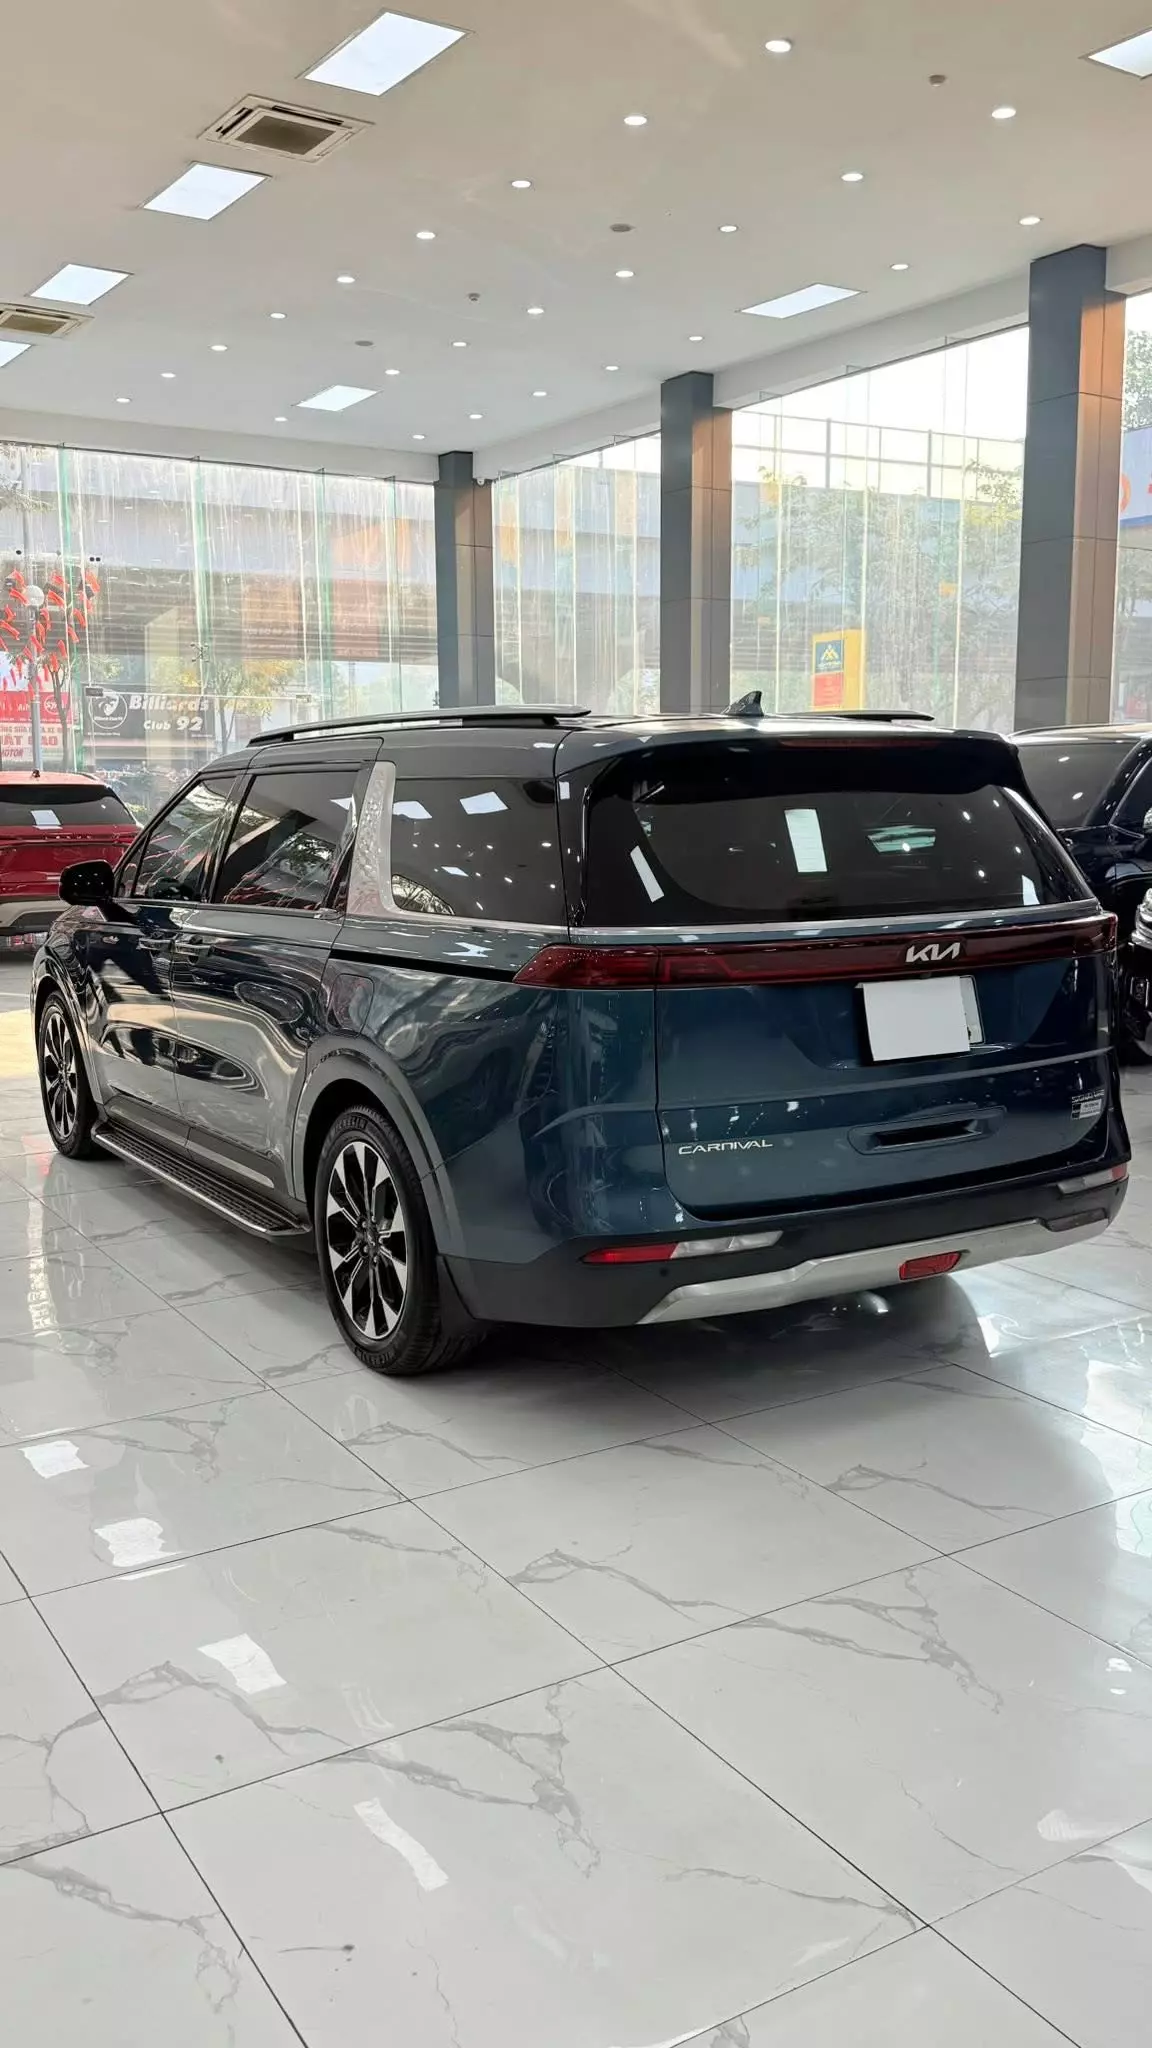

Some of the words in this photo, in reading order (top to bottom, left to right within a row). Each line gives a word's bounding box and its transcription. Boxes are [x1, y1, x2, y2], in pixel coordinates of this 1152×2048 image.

[128, 694, 209, 711] Billiards
[143, 719, 172, 730] Club
[176, 716, 203, 731] 92
[905, 942, 961, 962] KIA
[678, 1139, 773, 1155] CARNIVAL
